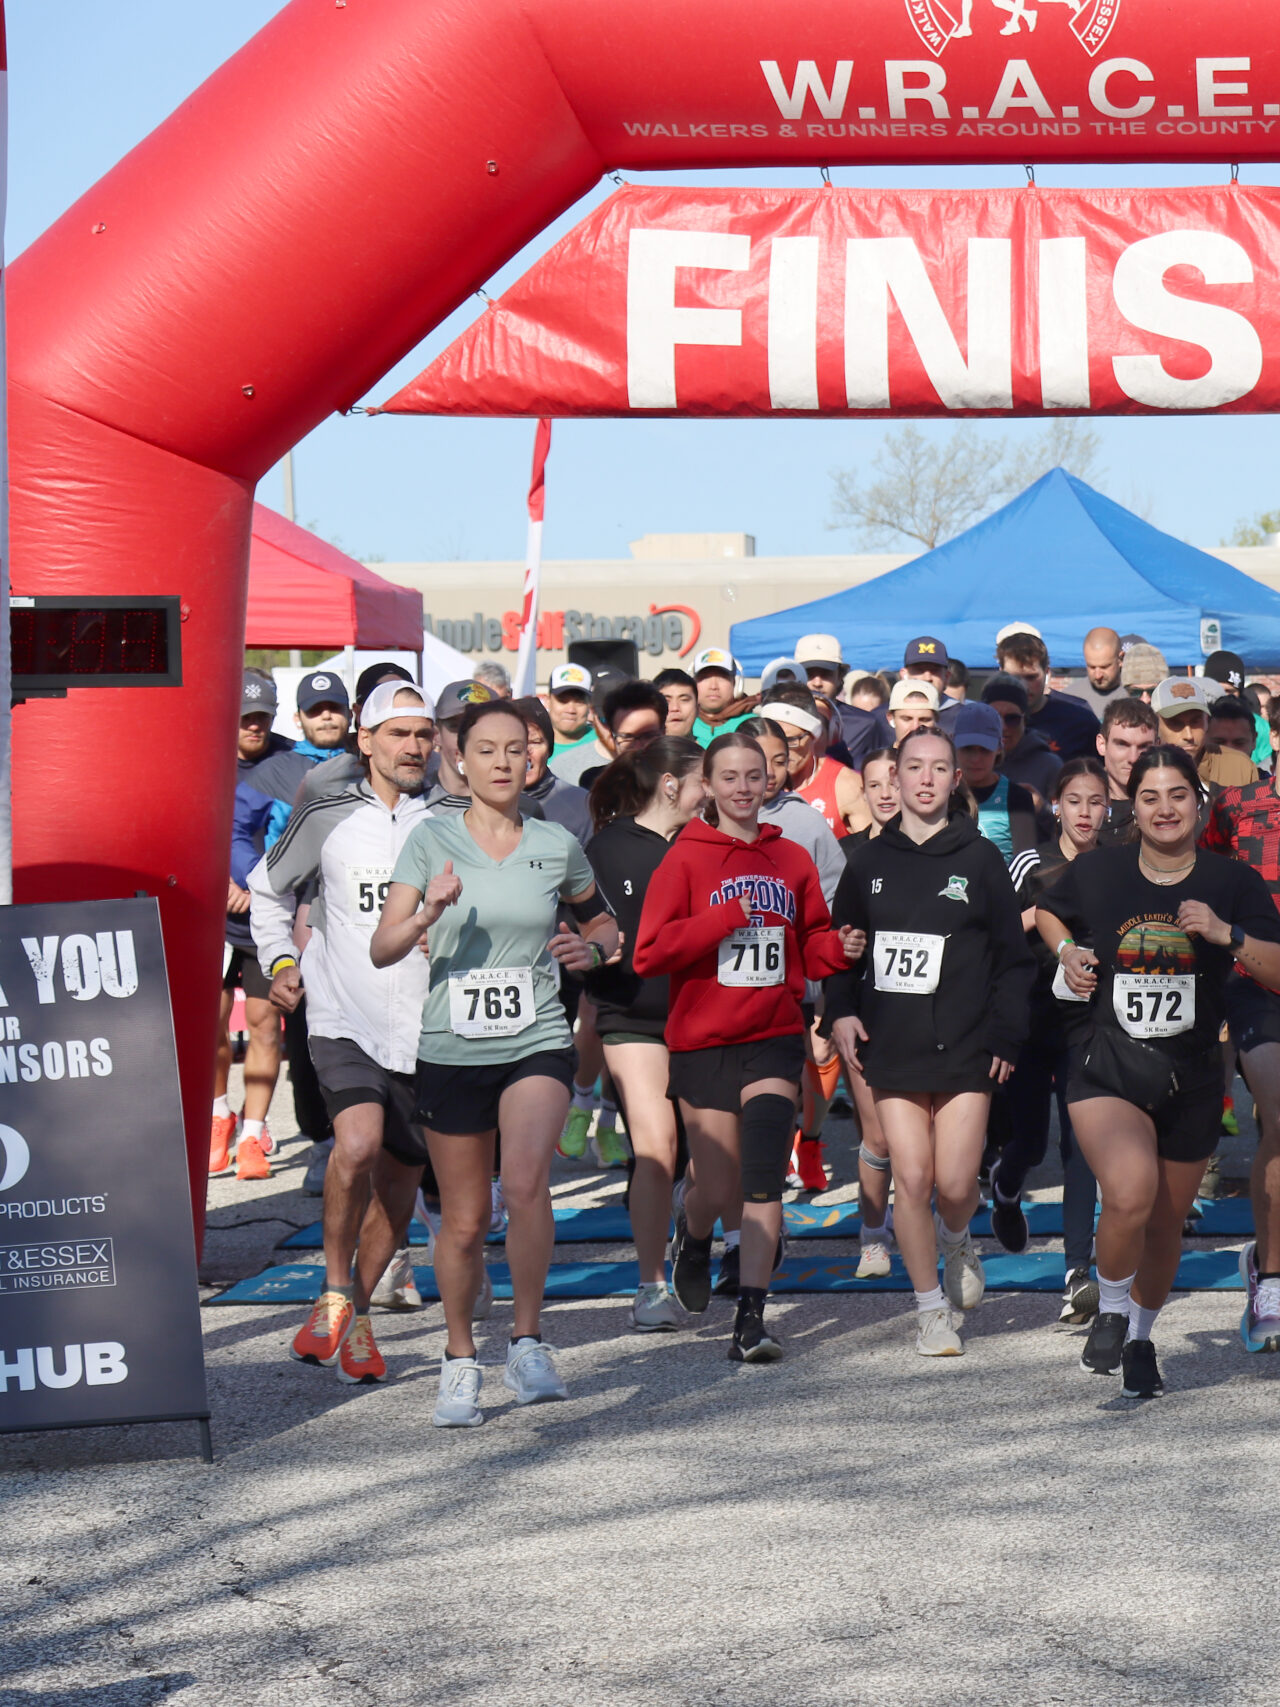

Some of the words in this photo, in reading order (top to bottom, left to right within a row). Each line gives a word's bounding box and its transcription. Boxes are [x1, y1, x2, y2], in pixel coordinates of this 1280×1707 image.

[760, 57, 1280, 120] W.R.A.C.E.
[623, 121, 768, 137] WALKERS
[779, 124, 798, 137] &
[807, 122, 948, 137] RUNNERS
[957, 122, 1081, 136] AROUND
[1090, 121, 1146, 135] THE
[1156, 120, 1275, 135] COUNTY
[918, 643, 935, 654] M
[624, 880, 633, 895] 3
[871, 878, 883, 894] 15
[1116, 915, 1142, 936] MIDDLE
[21, 930, 138, 1004] YOU
[731, 942, 780, 971] 716
[884, 948, 929, 978] 752
[463, 985, 521, 1020] 763
[1126, 991, 1182, 1022] 572
[13, 1270, 110, 1289] INSURANCE
[0, 1341, 128, 1393] HUB
